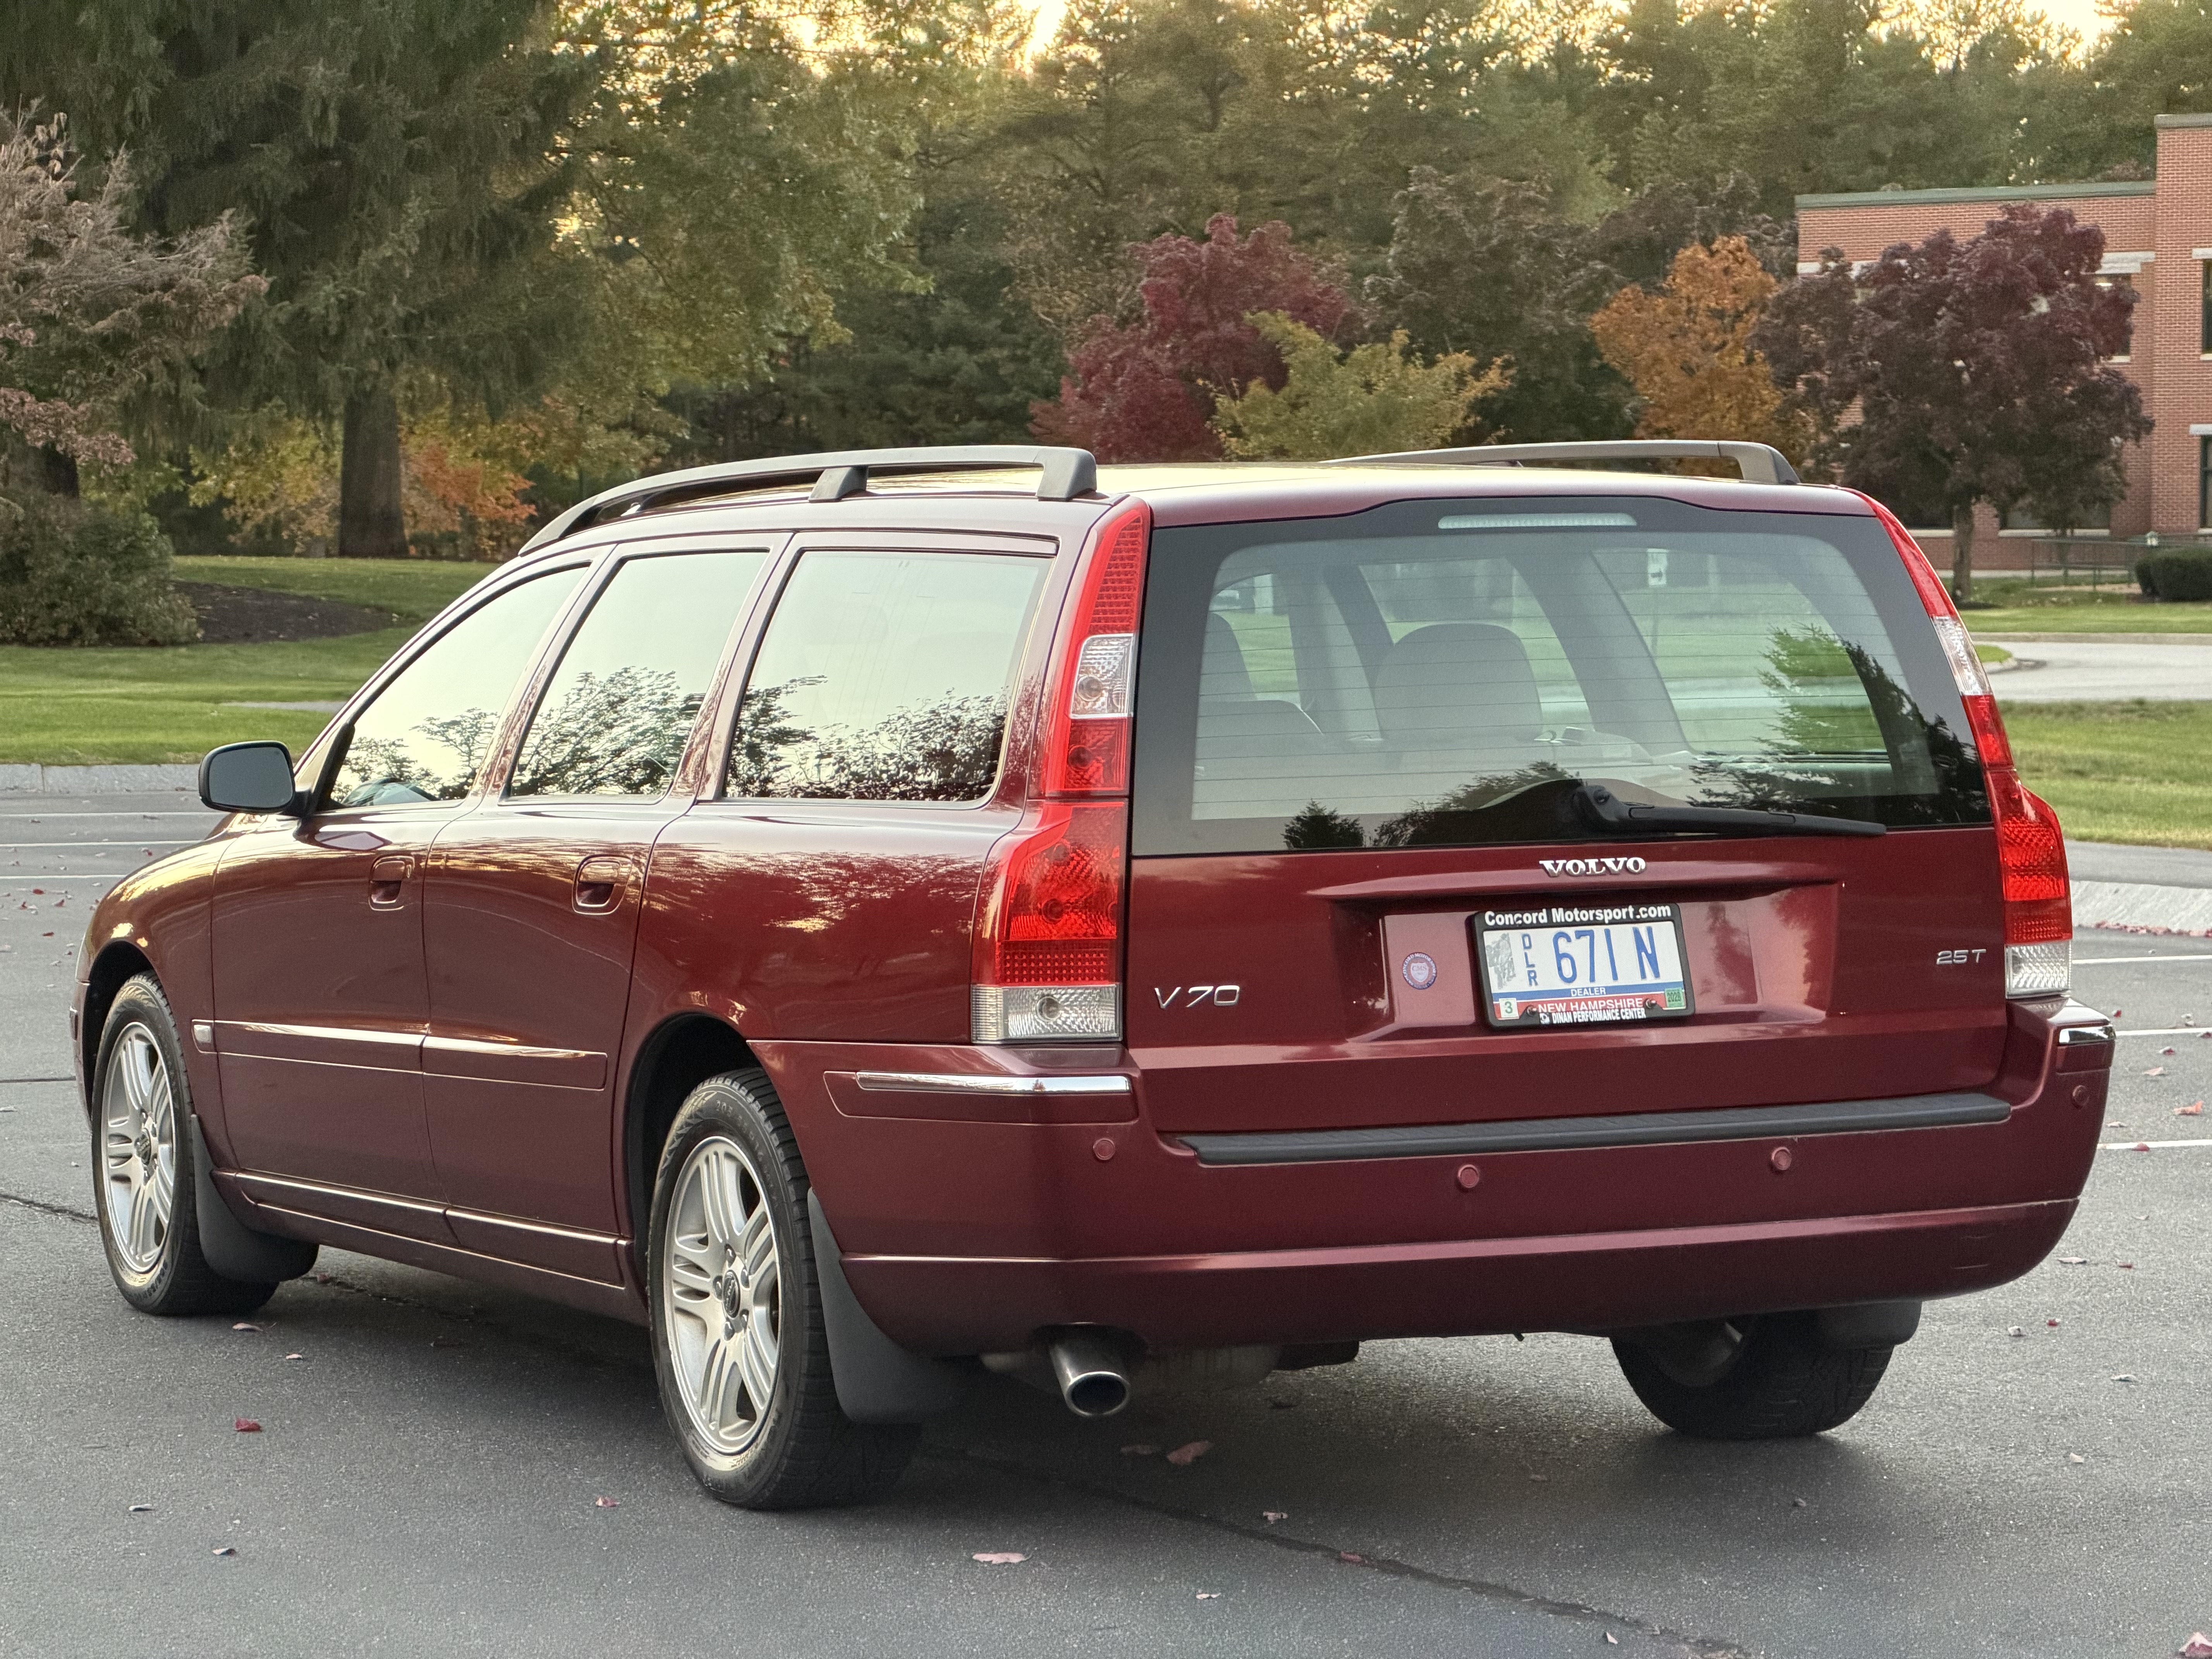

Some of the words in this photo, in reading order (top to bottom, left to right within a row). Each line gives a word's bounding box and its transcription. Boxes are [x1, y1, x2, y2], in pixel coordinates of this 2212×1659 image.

[1539, 857, 1646, 877] VOLVO
[1485, 908, 1548, 926] Concord
[1571, 987, 1606, 997] DEALER
[1504, 1001, 1513, 1013] 3
[1538, 1002, 1566, 1012] NEW
[1570, 998, 1643, 1011] HAMPSHIRE
[1552, 1010, 1573, 1024] DINAN
[1573, 1008, 1620, 1022] PERFORMANCE
[1620, 1008, 1646, 1020] CENTER
